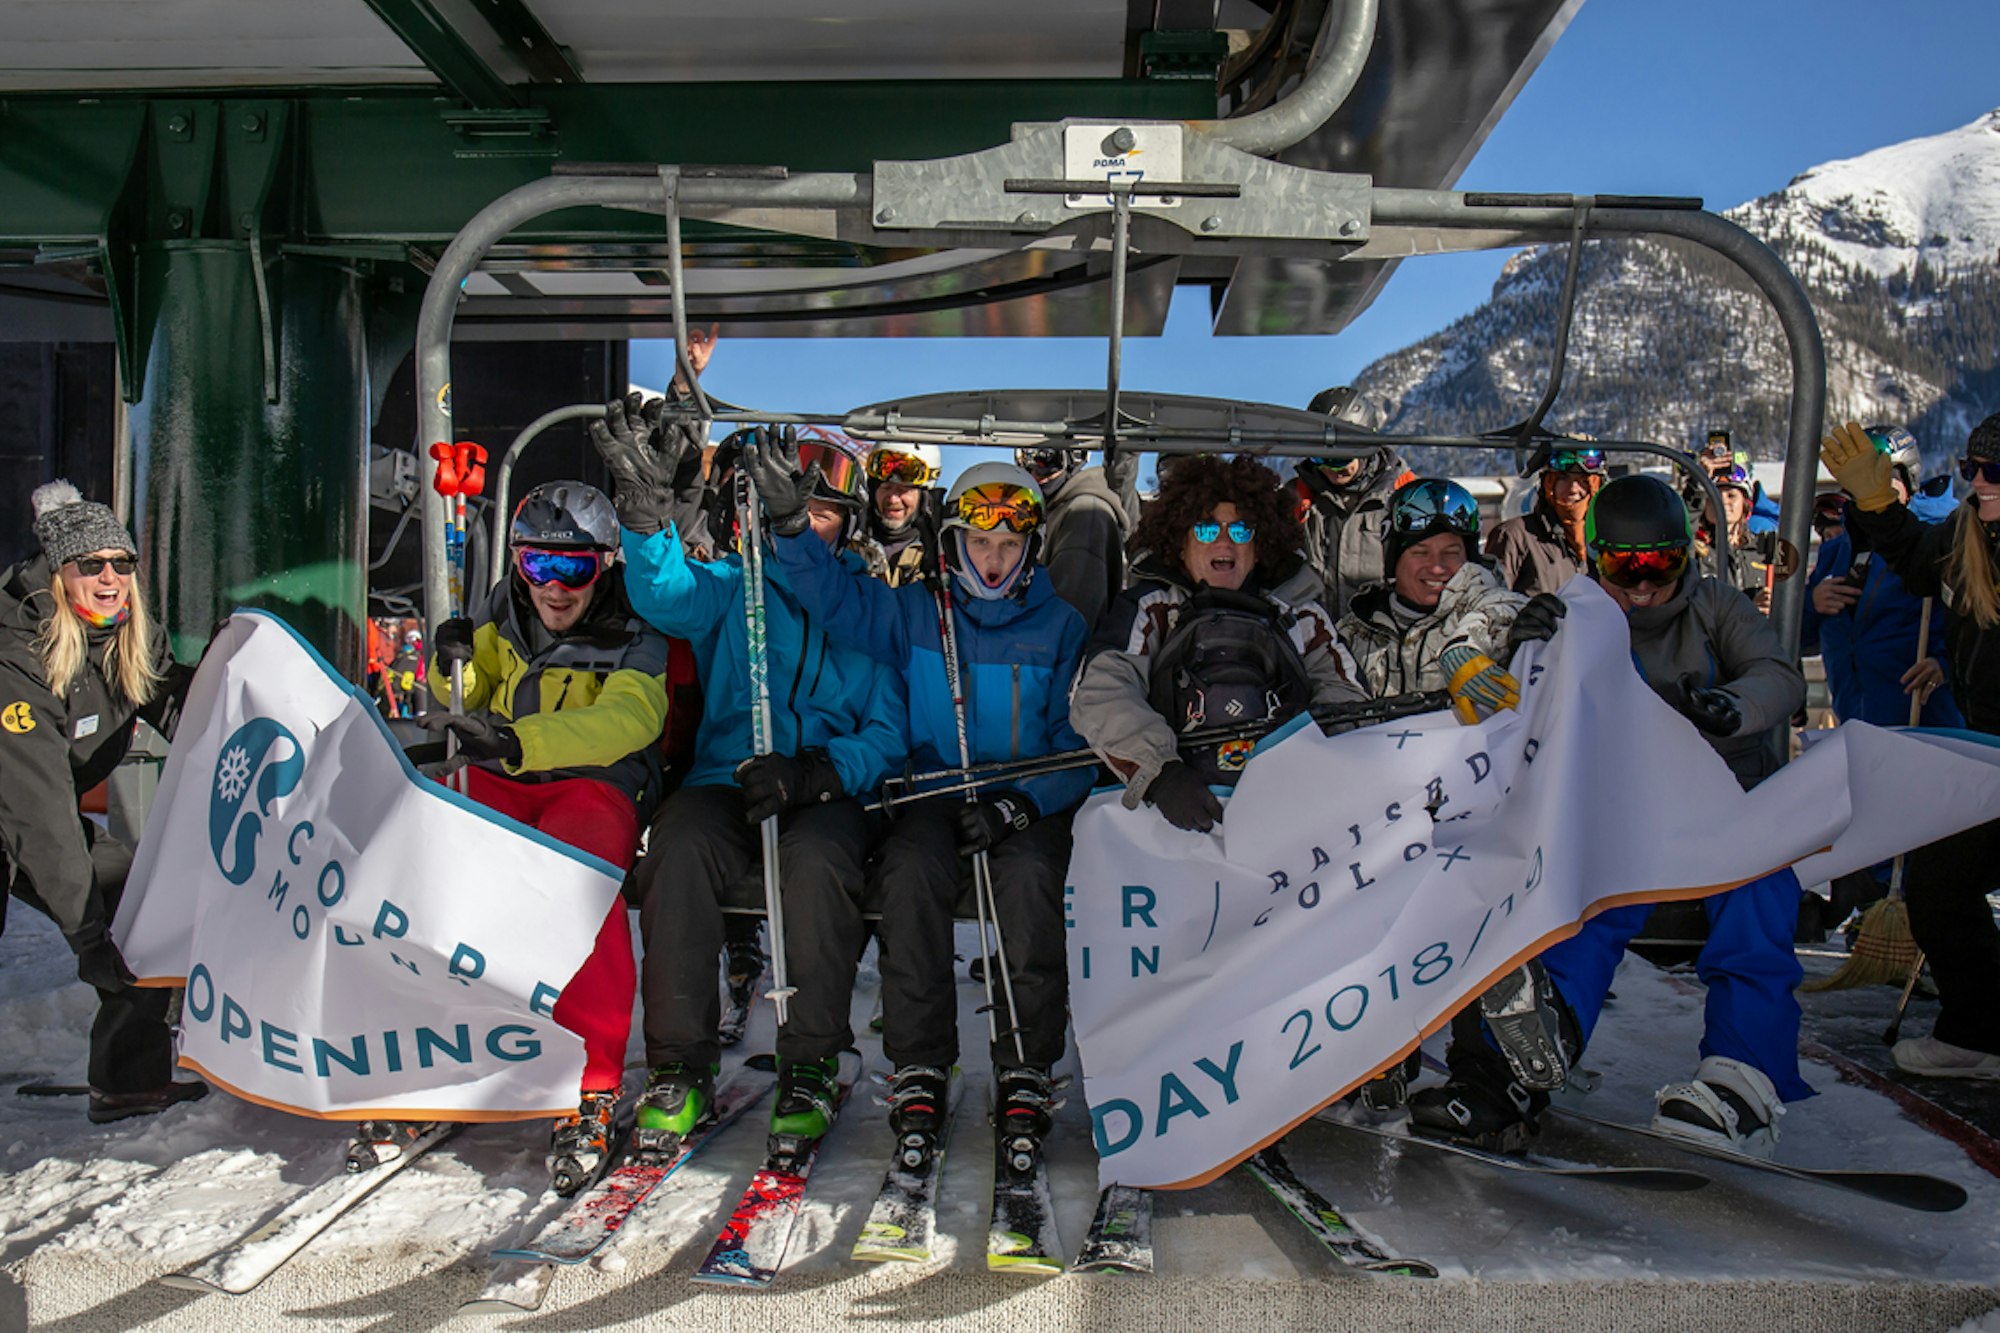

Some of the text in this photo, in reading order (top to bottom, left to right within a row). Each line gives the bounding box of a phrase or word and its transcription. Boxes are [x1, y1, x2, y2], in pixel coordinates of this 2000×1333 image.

[1093, 158, 1126, 168] POMA
[187, 962, 542, 1077] OPENING
[1089, 1040, 1245, 1158] DAY
